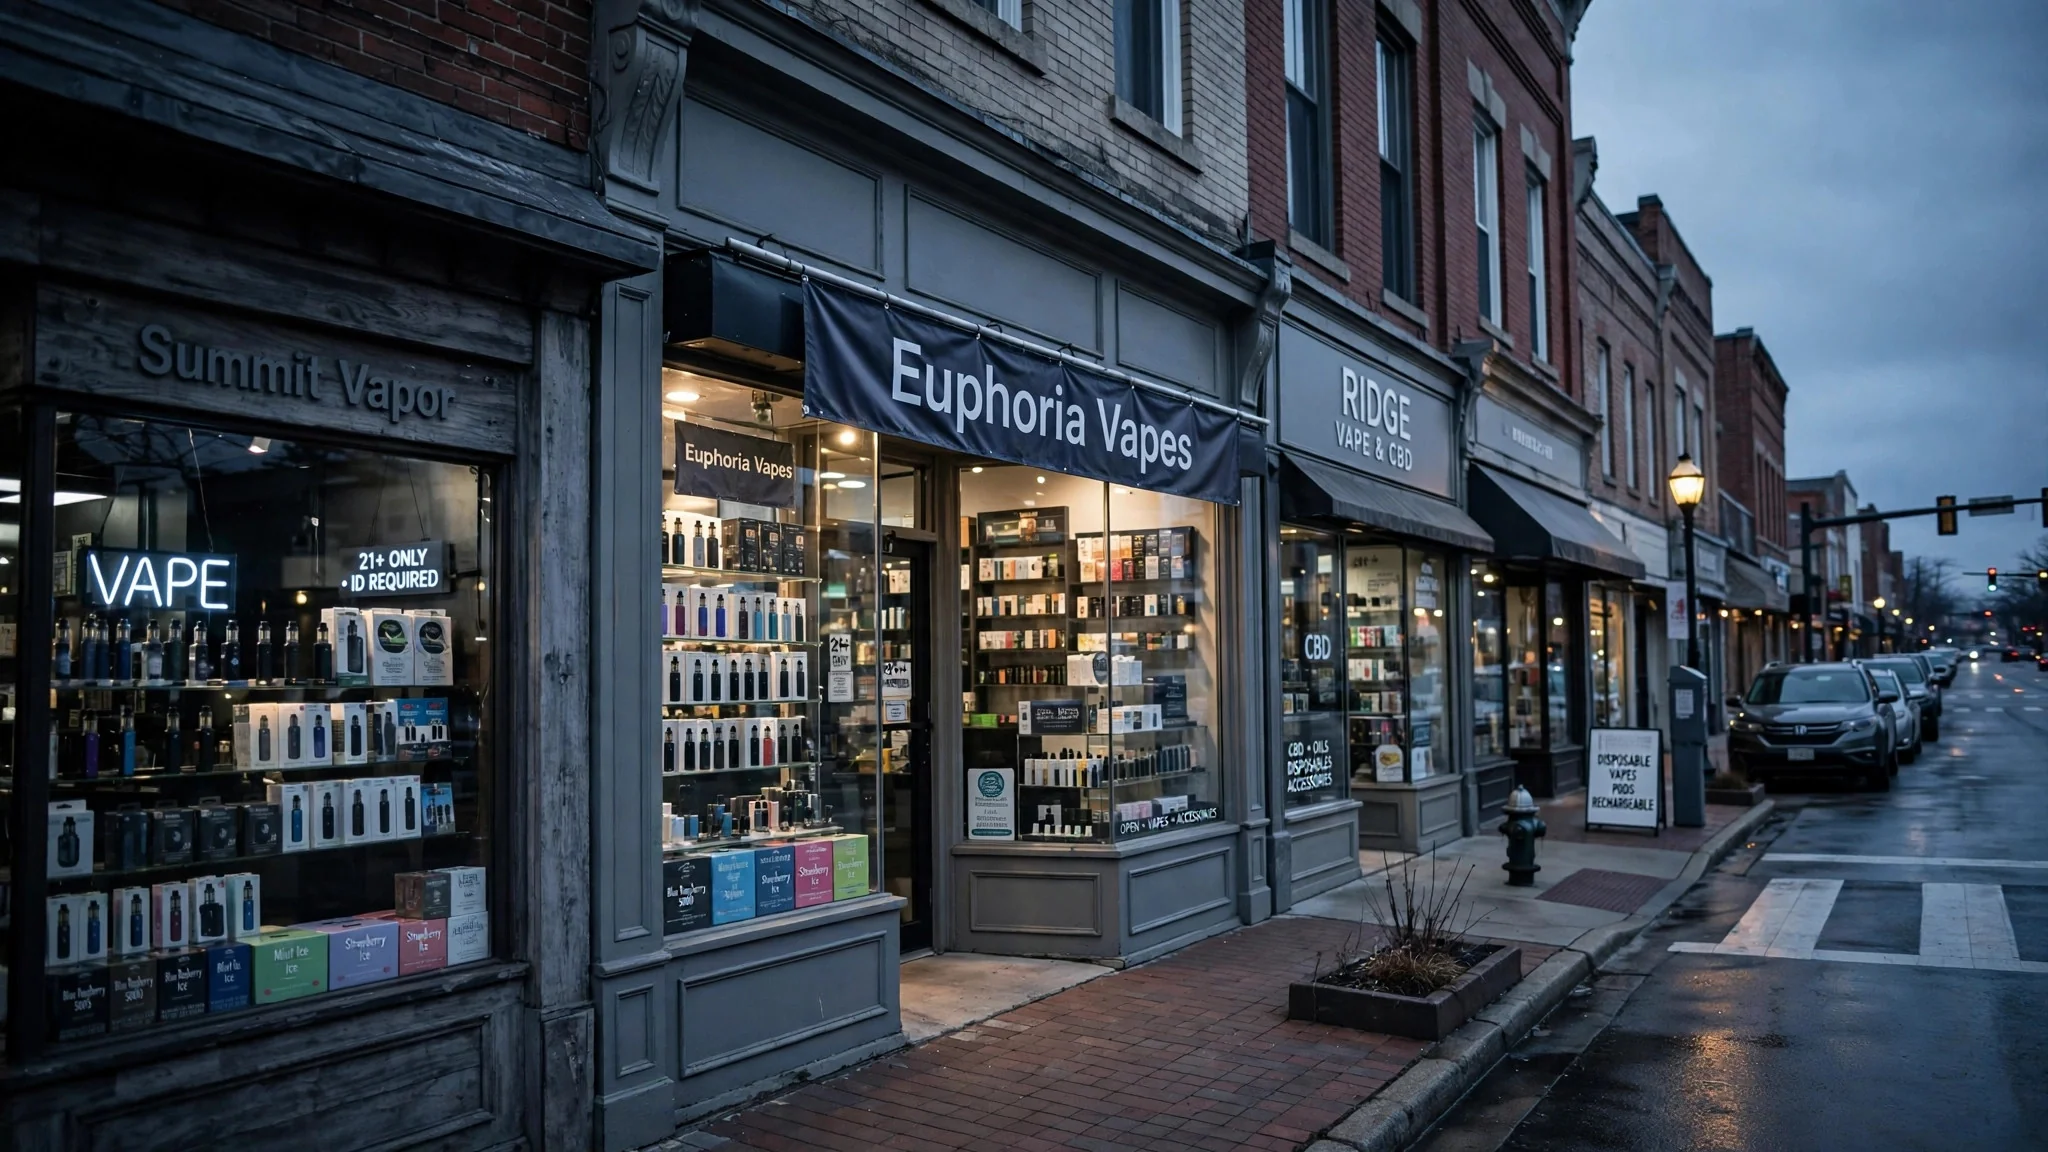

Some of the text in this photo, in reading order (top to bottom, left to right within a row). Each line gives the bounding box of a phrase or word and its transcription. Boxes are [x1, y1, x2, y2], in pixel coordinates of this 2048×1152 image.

[139, 324, 456, 424] Summit Vapor
[890, 337, 1193, 474] Euphoria Vapes
[1341, 366, 1412, 441] RIDGE
[1334, 414, 1413, 472] VAPE & CBD
[684, 441, 794, 481] Euphoria Vapes
[358, 548, 428, 571] 21+ ONLY
[88, 553, 232, 611] VAPE
[351, 569, 439, 591] ID REQUIRED
[1304, 632, 1332, 661] CBD
[1288, 739, 1329, 757] CBD OILS
[1597, 754, 1652, 768] DISPOSABLE
[1609, 768, 1637, 781] VAPES
[1119, 820, 1141, 834] OPEN
